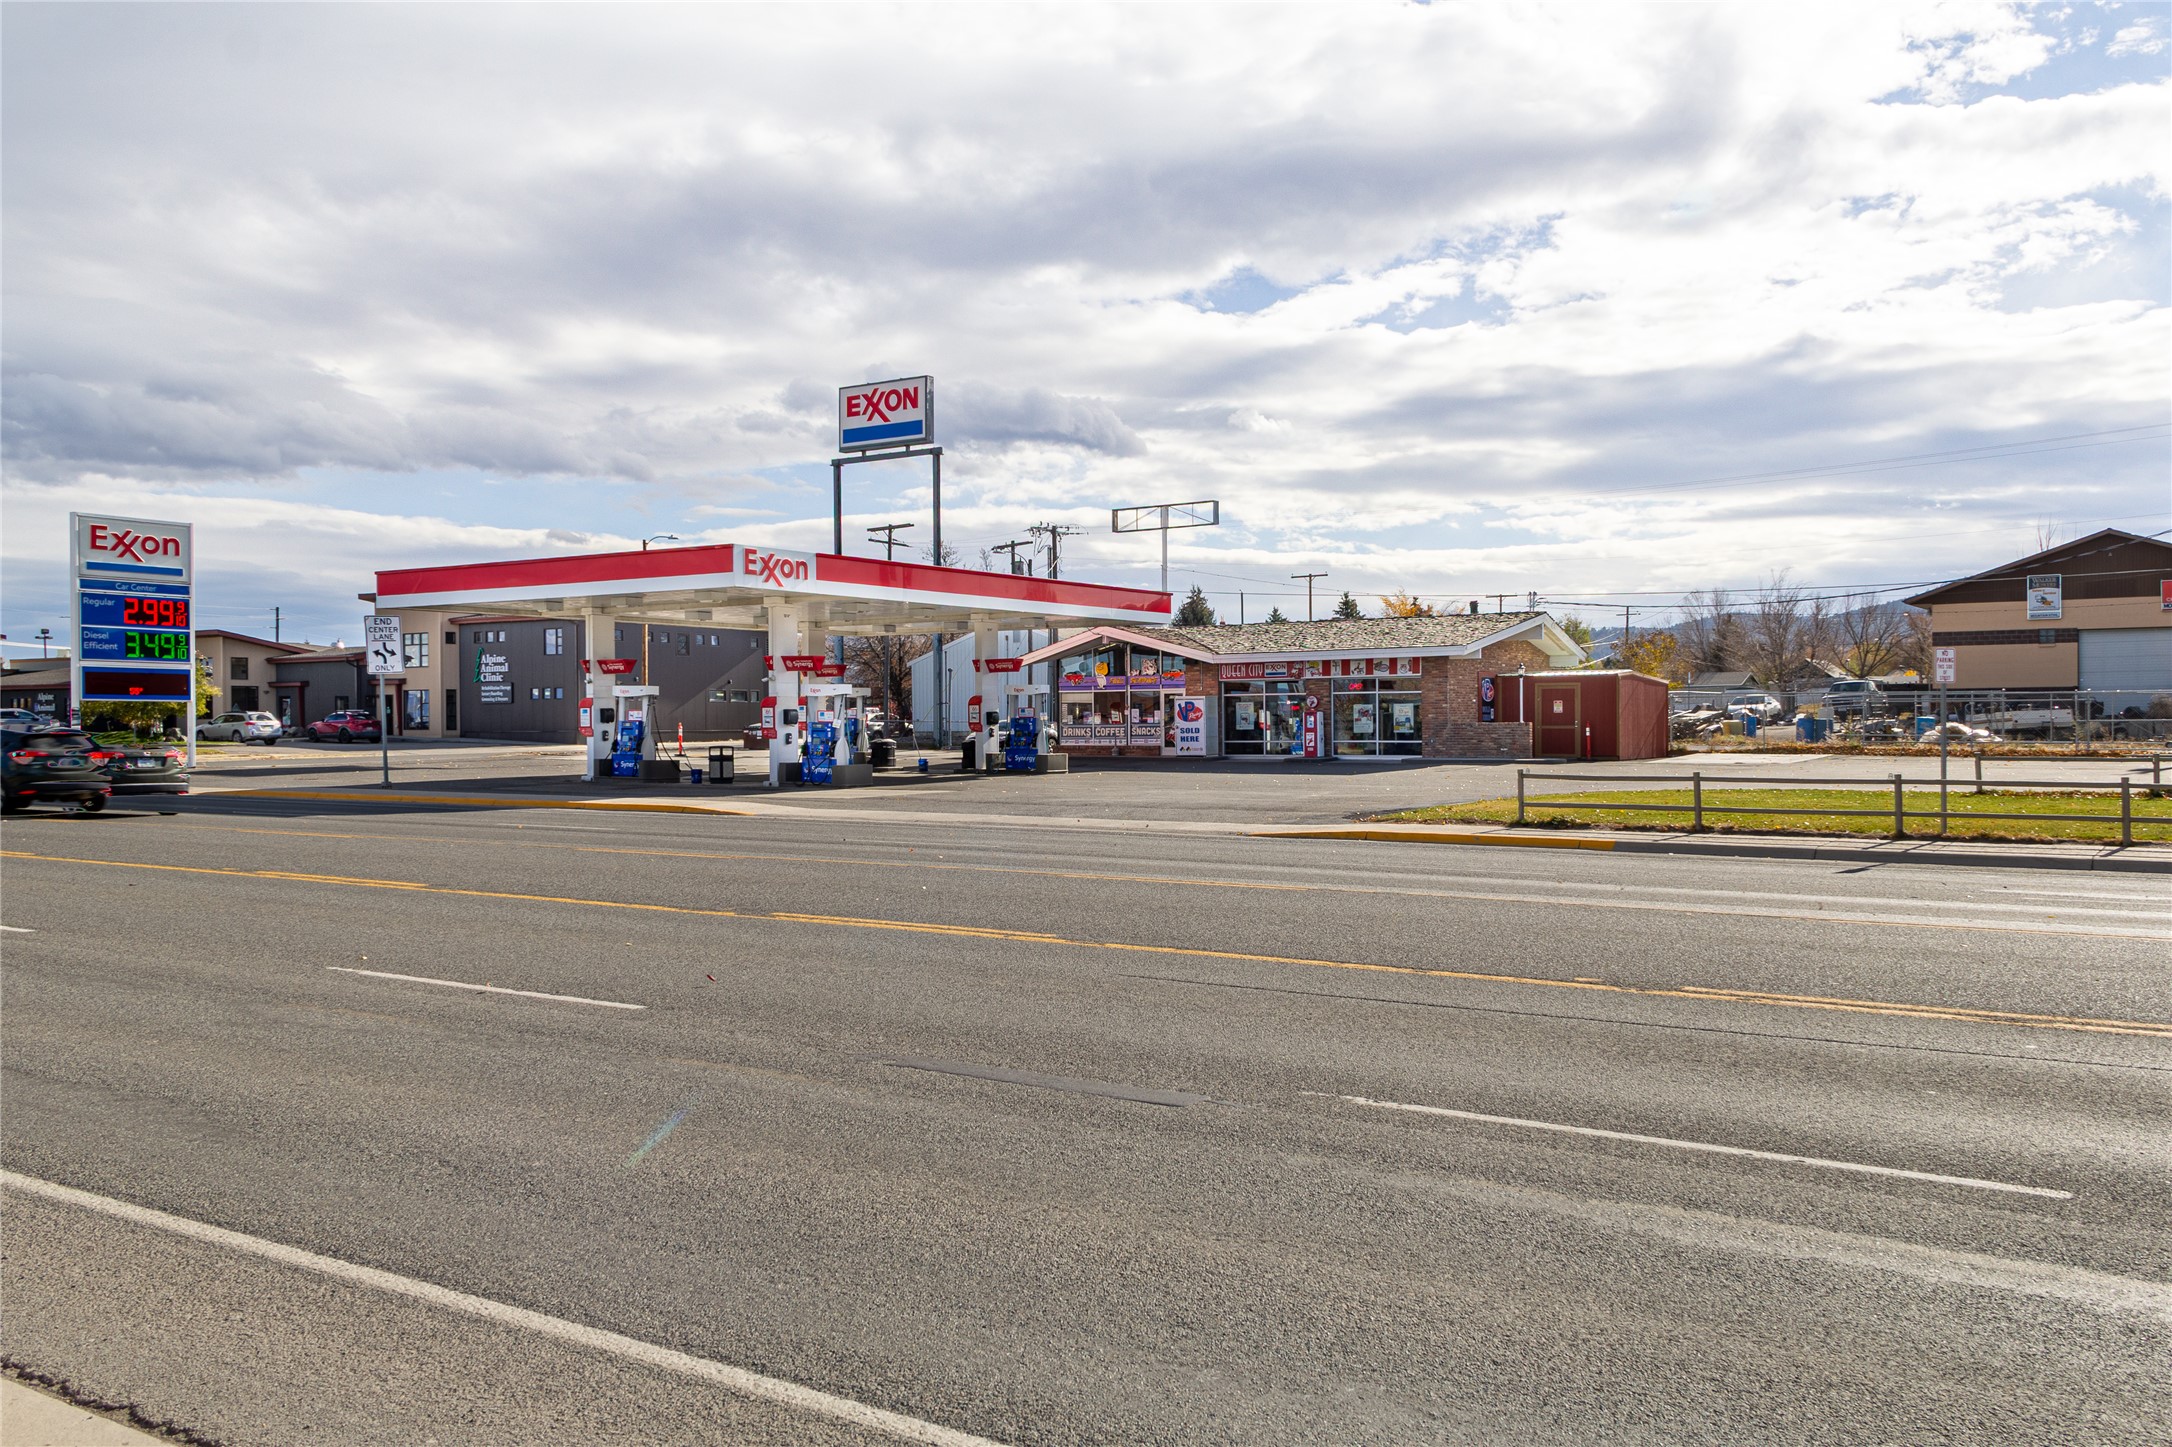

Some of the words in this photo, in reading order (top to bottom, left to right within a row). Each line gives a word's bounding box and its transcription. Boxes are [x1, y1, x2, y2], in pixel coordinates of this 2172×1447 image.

[846, 386, 919, 423] EXXON
[90, 524, 181, 563] Exxon
[744, 548, 808, 588] Exxon
[115, 582, 129, 591] Car
[131, 584, 157, 592] Center
[83, 597, 115, 607] Regular
[374, 617, 392, 625] END
[83, 631, 109, 639] Diesel
[83, 641, 118, 650] Efficient
[481, 654, 507, 665] Alpine
[481, 662, 509, 672] Animal
[1221, 664, 1246, 678] QUEEN
[1248, 664, 1263, 677] CITY
[1265, 664, 1286, 672] EXXON
[481, 672, 504, 682] Clinic
[37, 693, 55, 702] Alpine
[1063, 728, 1092, 736] DRINKS
[1095, 727, 1125, 736] COFFEE
[1131, 727, 1161, 735] SNACKS
